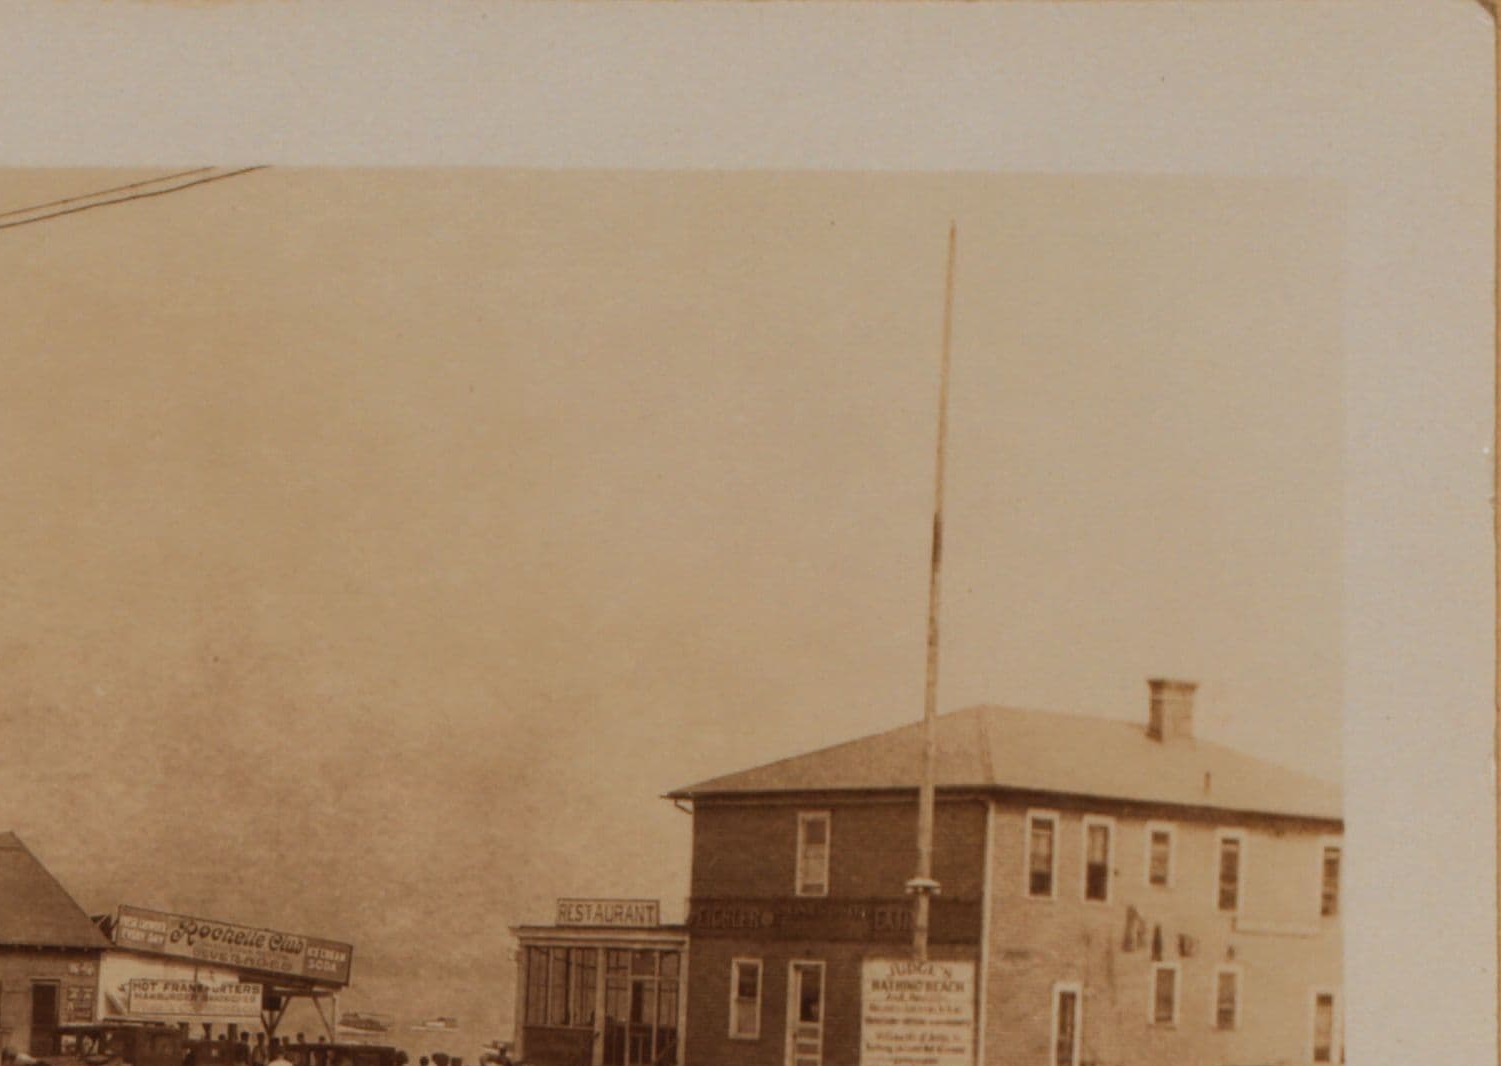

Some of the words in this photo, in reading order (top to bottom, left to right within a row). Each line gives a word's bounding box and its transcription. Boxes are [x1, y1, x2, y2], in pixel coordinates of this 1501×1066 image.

[558, 902, 656, 923] RESTAURANT
[170, 919, 266, 949] Rochelle
[268, 930, 305, 955] Club
[307, 959, 337, 971] SODA
[132, 983, 157, 993] HOT
